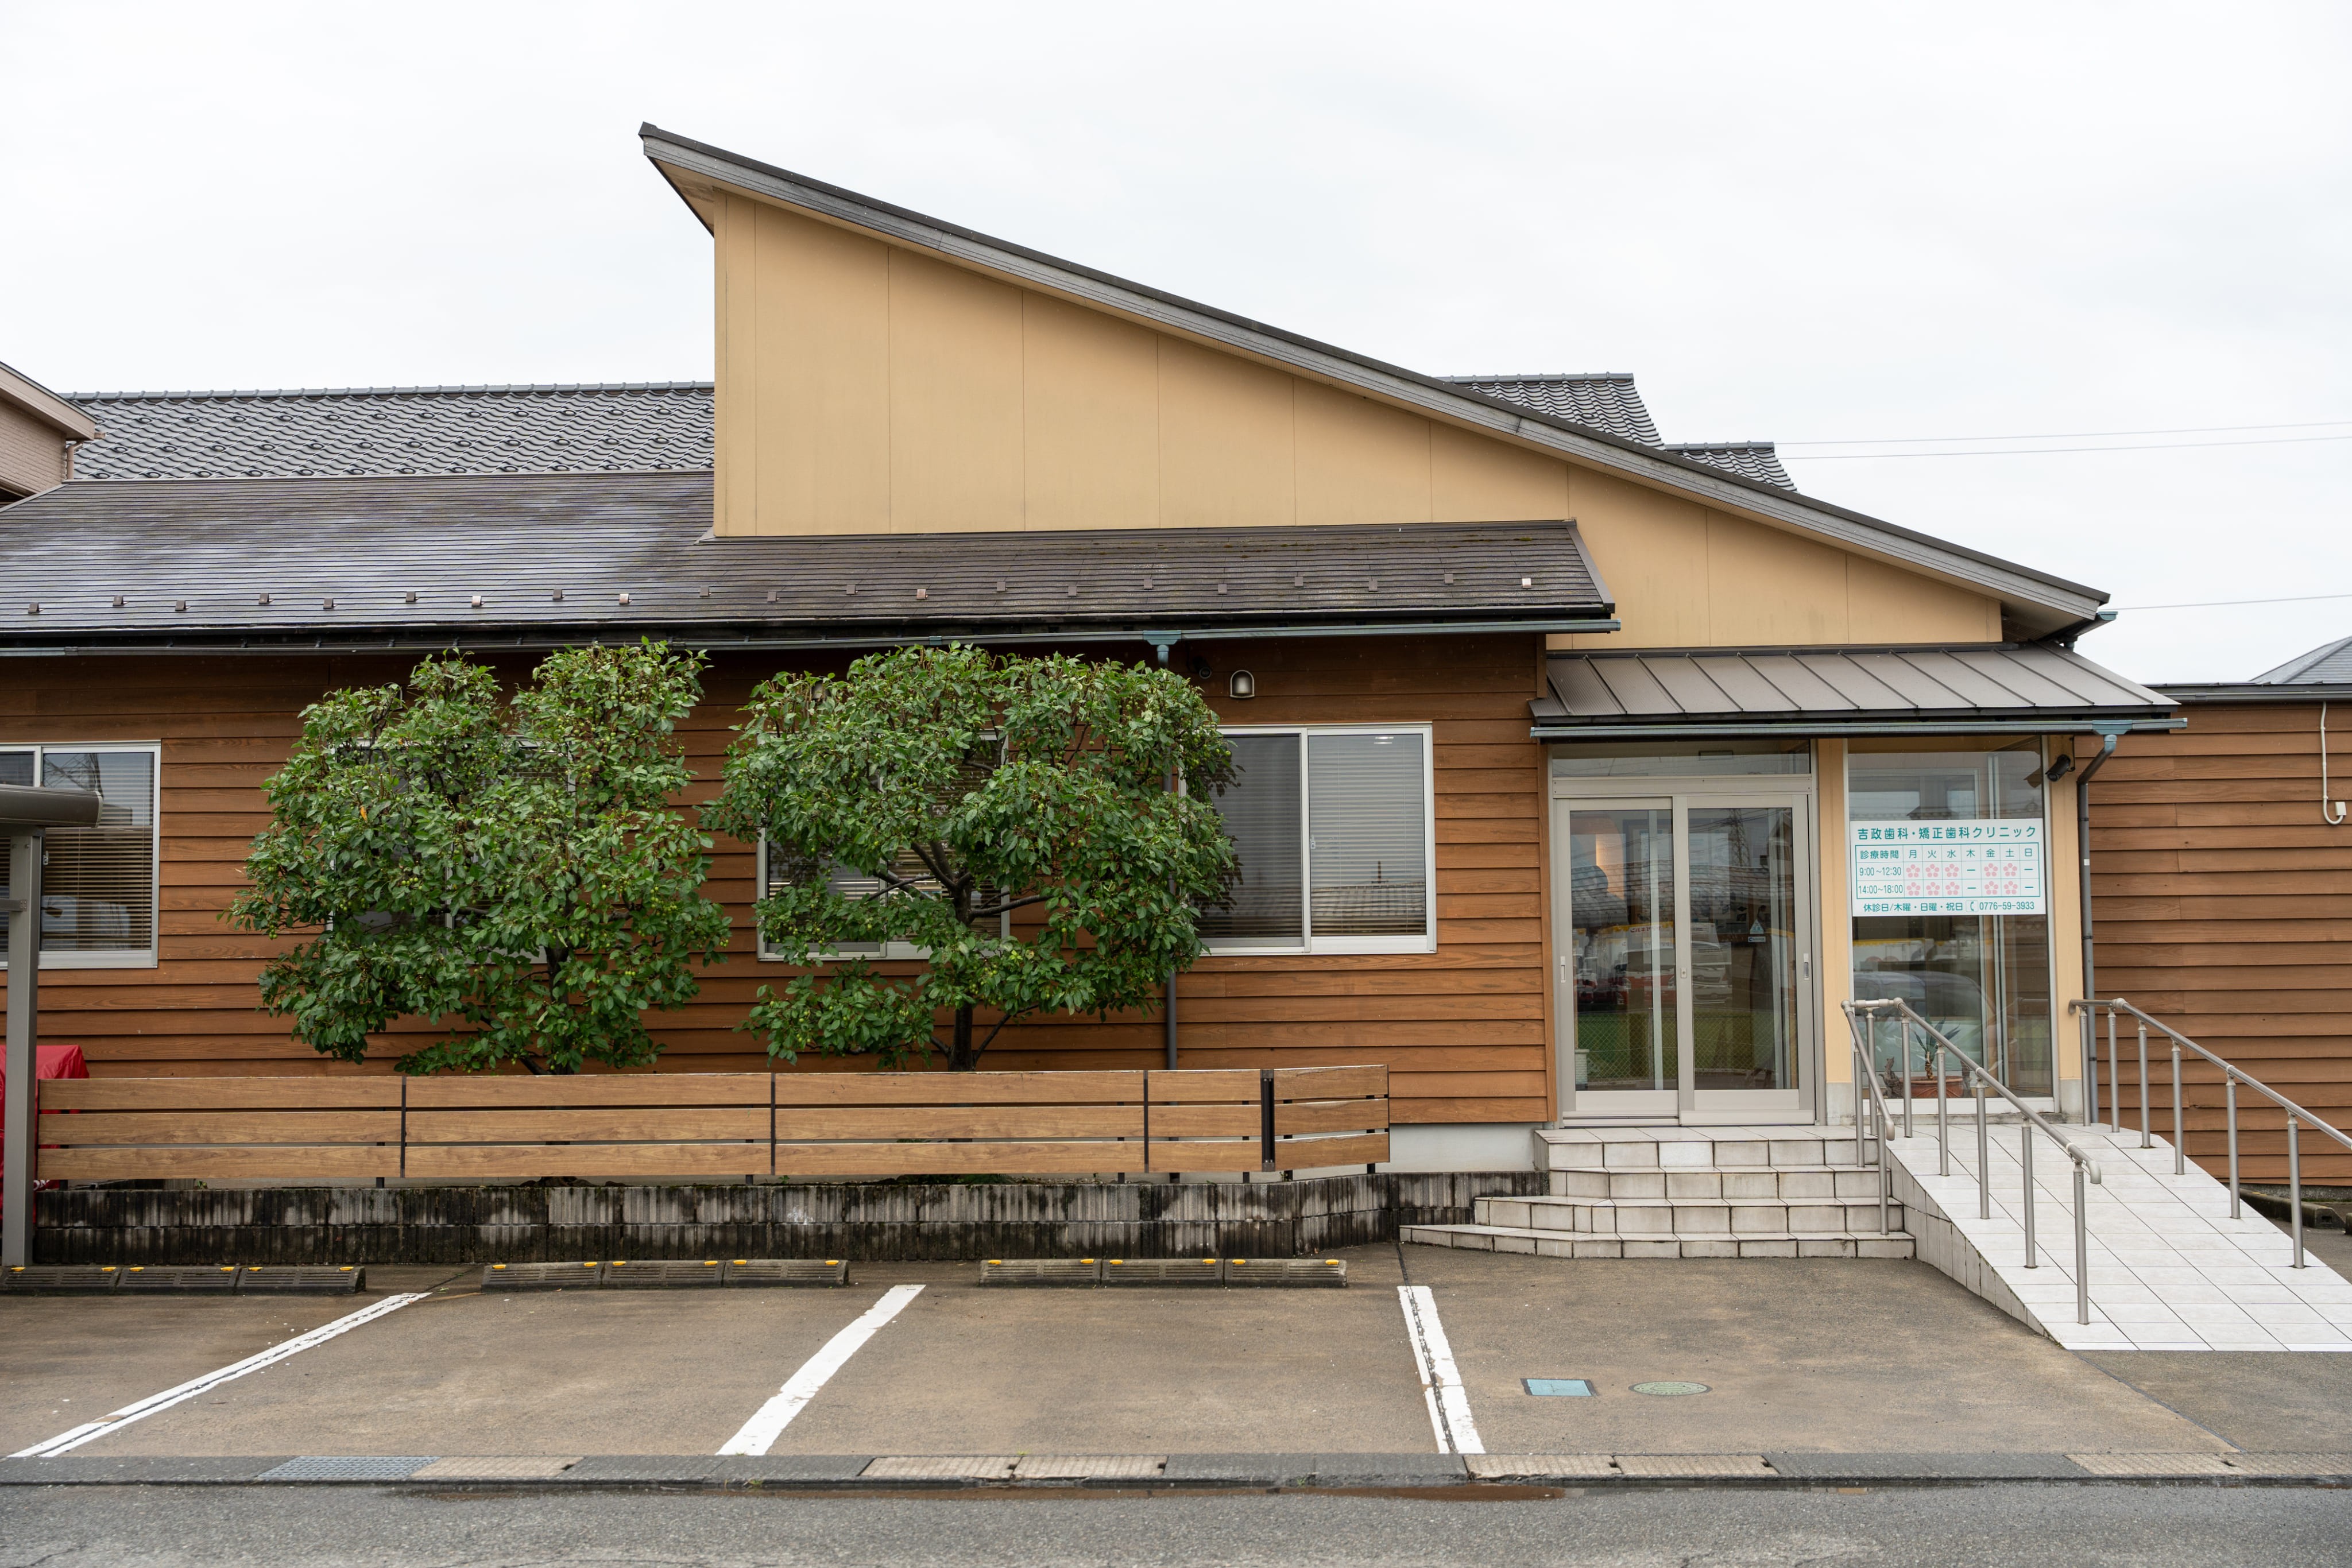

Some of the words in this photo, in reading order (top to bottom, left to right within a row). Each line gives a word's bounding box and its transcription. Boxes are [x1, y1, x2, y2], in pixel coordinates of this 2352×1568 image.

[1858, 826, 2036, 840] 吉政歯科・矯正歯科クリニック
[1860, 850, 1899, 860] 診療時間
[1909, 850, 1917, 859] 月
[1928, 849, 1937, 858] 火
[1947, 849, 1956, 858] 水
[1966, 849, 1975, 858] 木
[1986, 849, 1995, 858] 金
[2005, 849, 2014, 857] 土
[2025, 848, 2033, 857] 日
[1979, 901, 2034, 910] 0776-59-3933
